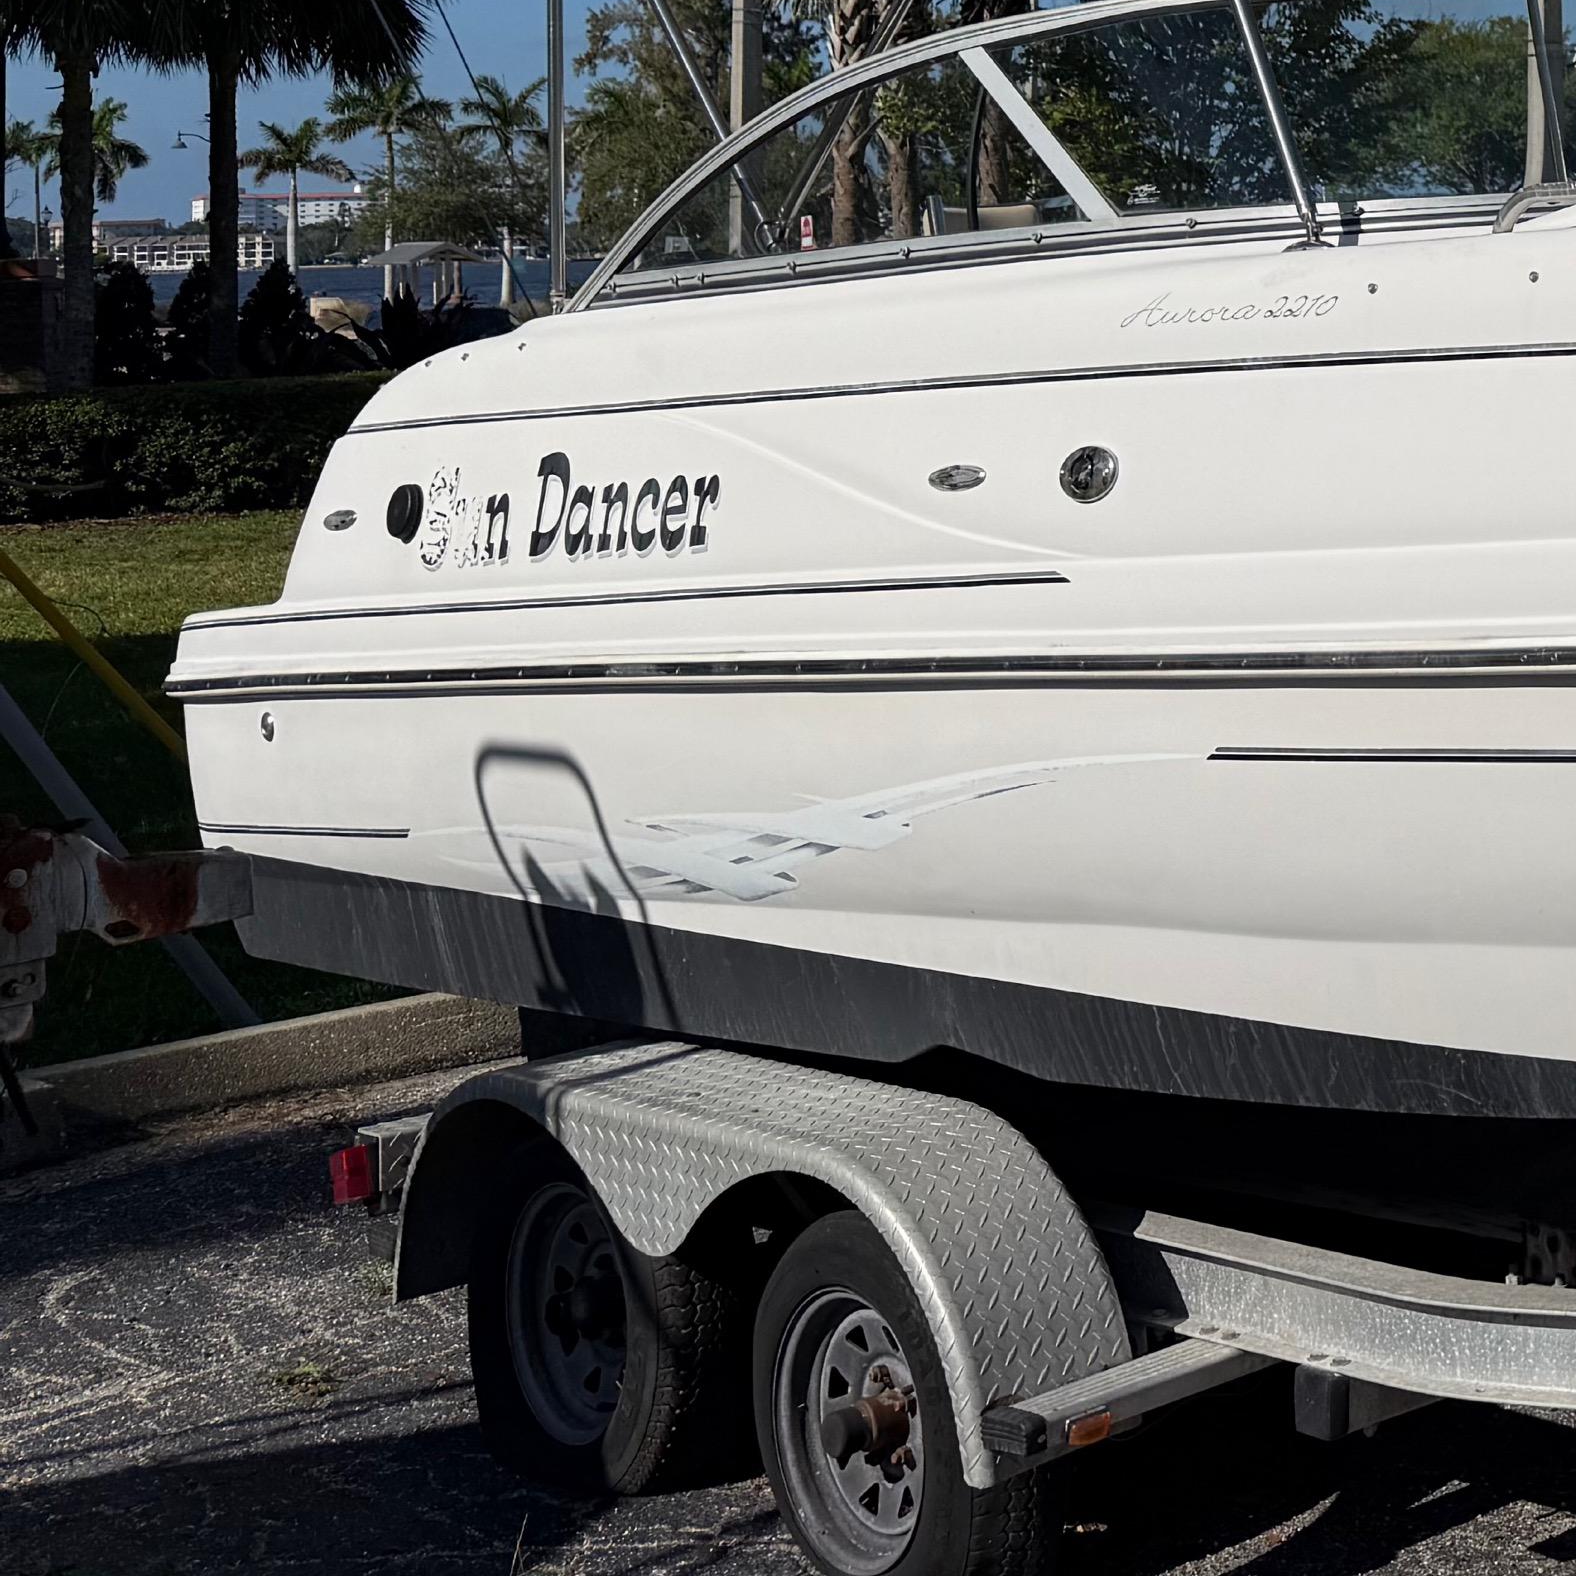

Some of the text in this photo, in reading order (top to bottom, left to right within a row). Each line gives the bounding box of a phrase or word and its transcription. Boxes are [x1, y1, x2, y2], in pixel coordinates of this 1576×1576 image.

[1120, 291, 1339, 328] Aurora 2210
[529, 451, 721, 563] Dancer
